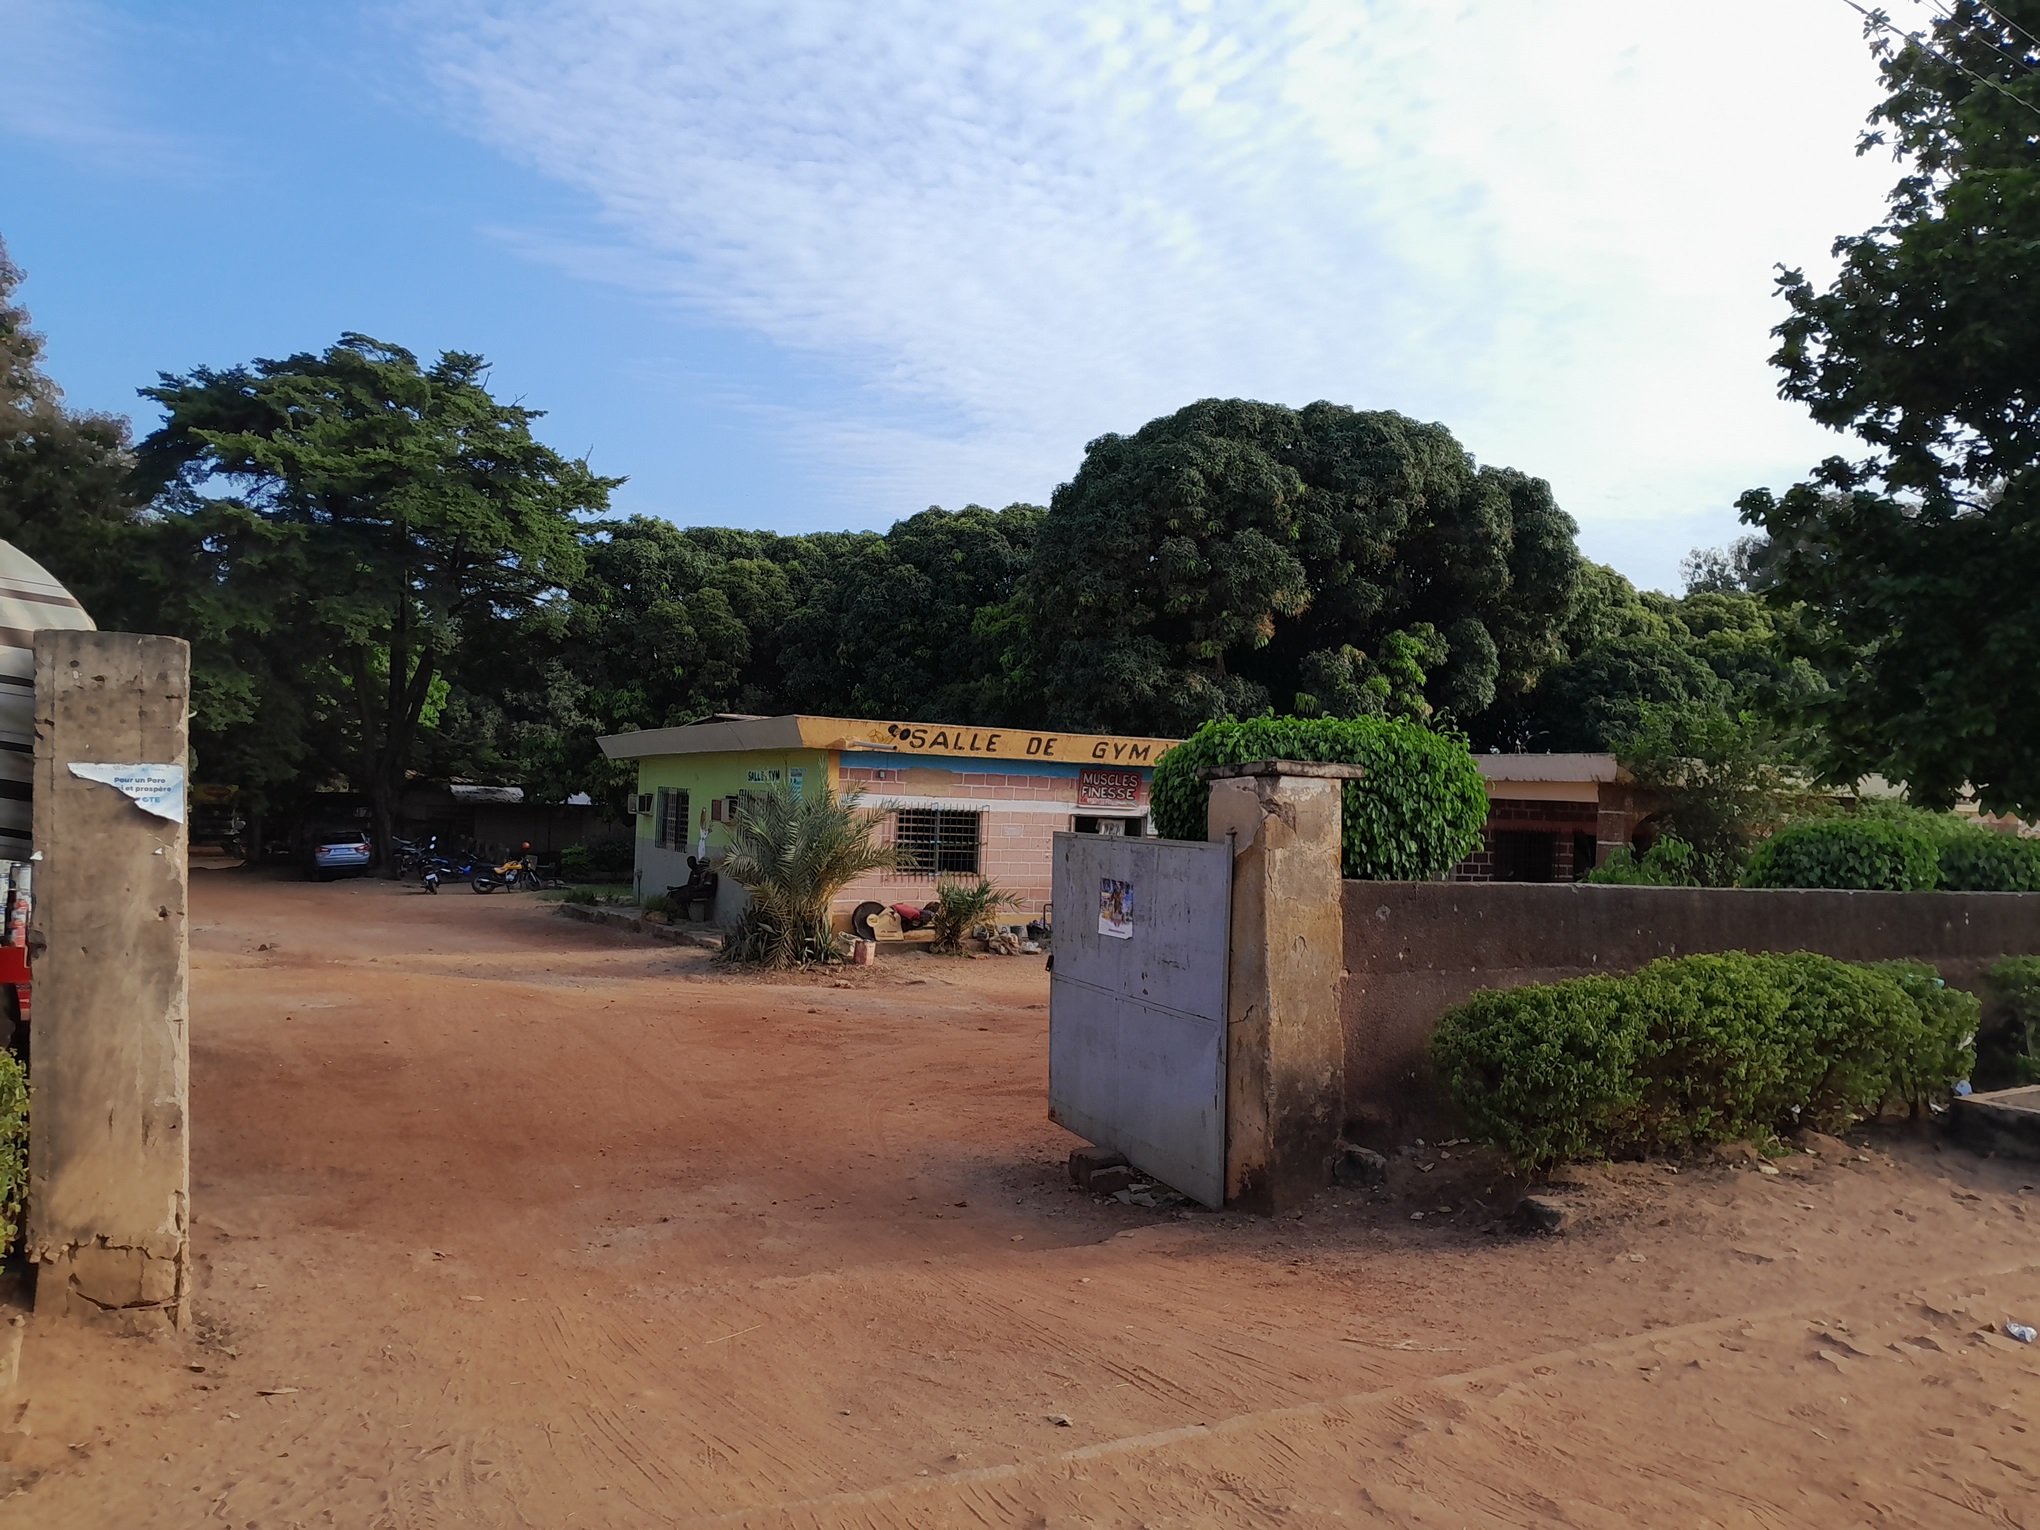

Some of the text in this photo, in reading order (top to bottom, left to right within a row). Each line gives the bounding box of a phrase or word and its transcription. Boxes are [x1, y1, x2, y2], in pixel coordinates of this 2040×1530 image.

[909, 729, 1002, 752] SALLE
[1026, 737, 1057, 756] DE
[1092, 742, 1151, 761] GYM
[1083, 772, 1138, 787] MUSCLES
[1081, 786, 1135, 800] FINESSE
